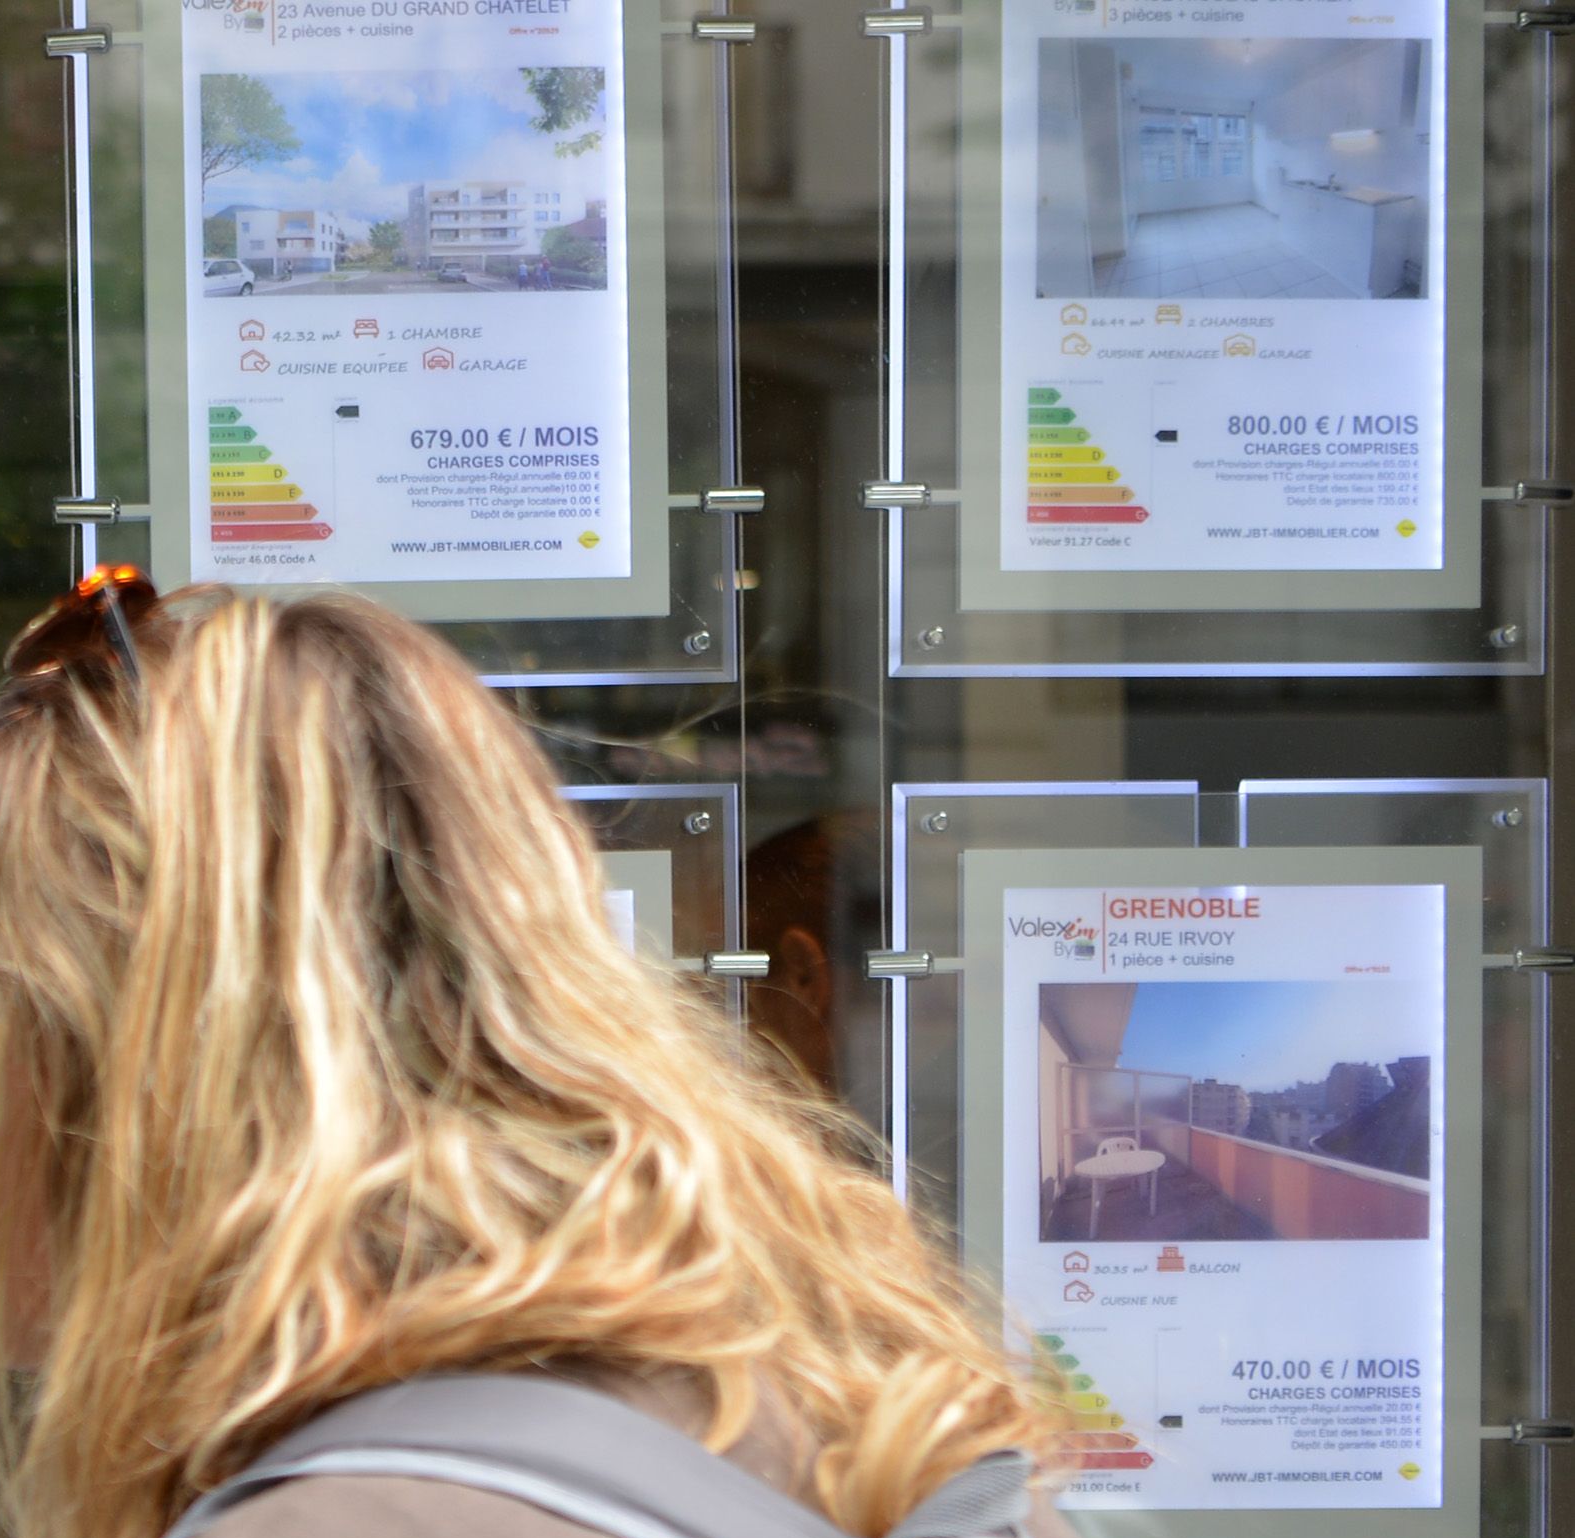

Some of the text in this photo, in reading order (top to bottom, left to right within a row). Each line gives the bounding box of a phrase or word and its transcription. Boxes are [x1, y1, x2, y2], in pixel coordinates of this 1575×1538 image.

[277, 3, 298, 20] 23
[302, 3, 366, 18] Avenue
[371, 1, 398, 17] DU
[402, 0, 469, 17] GRAND
[1227, 415, 1307, 436] 800.00
[1315, 415, 1330, 436] €
[1352, 414, 1419, 435] MOIS
[410, 428, 489, 449] 679.00
[497, 428, 512, 448] €
[534, 426, 599, 447] MOIS
[1243, 442, 1419, 456] CHARGES COMPRISES
[1109, 893, 1260, 919] GRENOBLE
[1107, 930, 1235, 947] 24 RUE IRVOY
[1231, 1359, 1311, 1380] 470.00
[1319, 1359, 1334, 1379] €
[1356, 1358, 1421, 1379] MOIS
